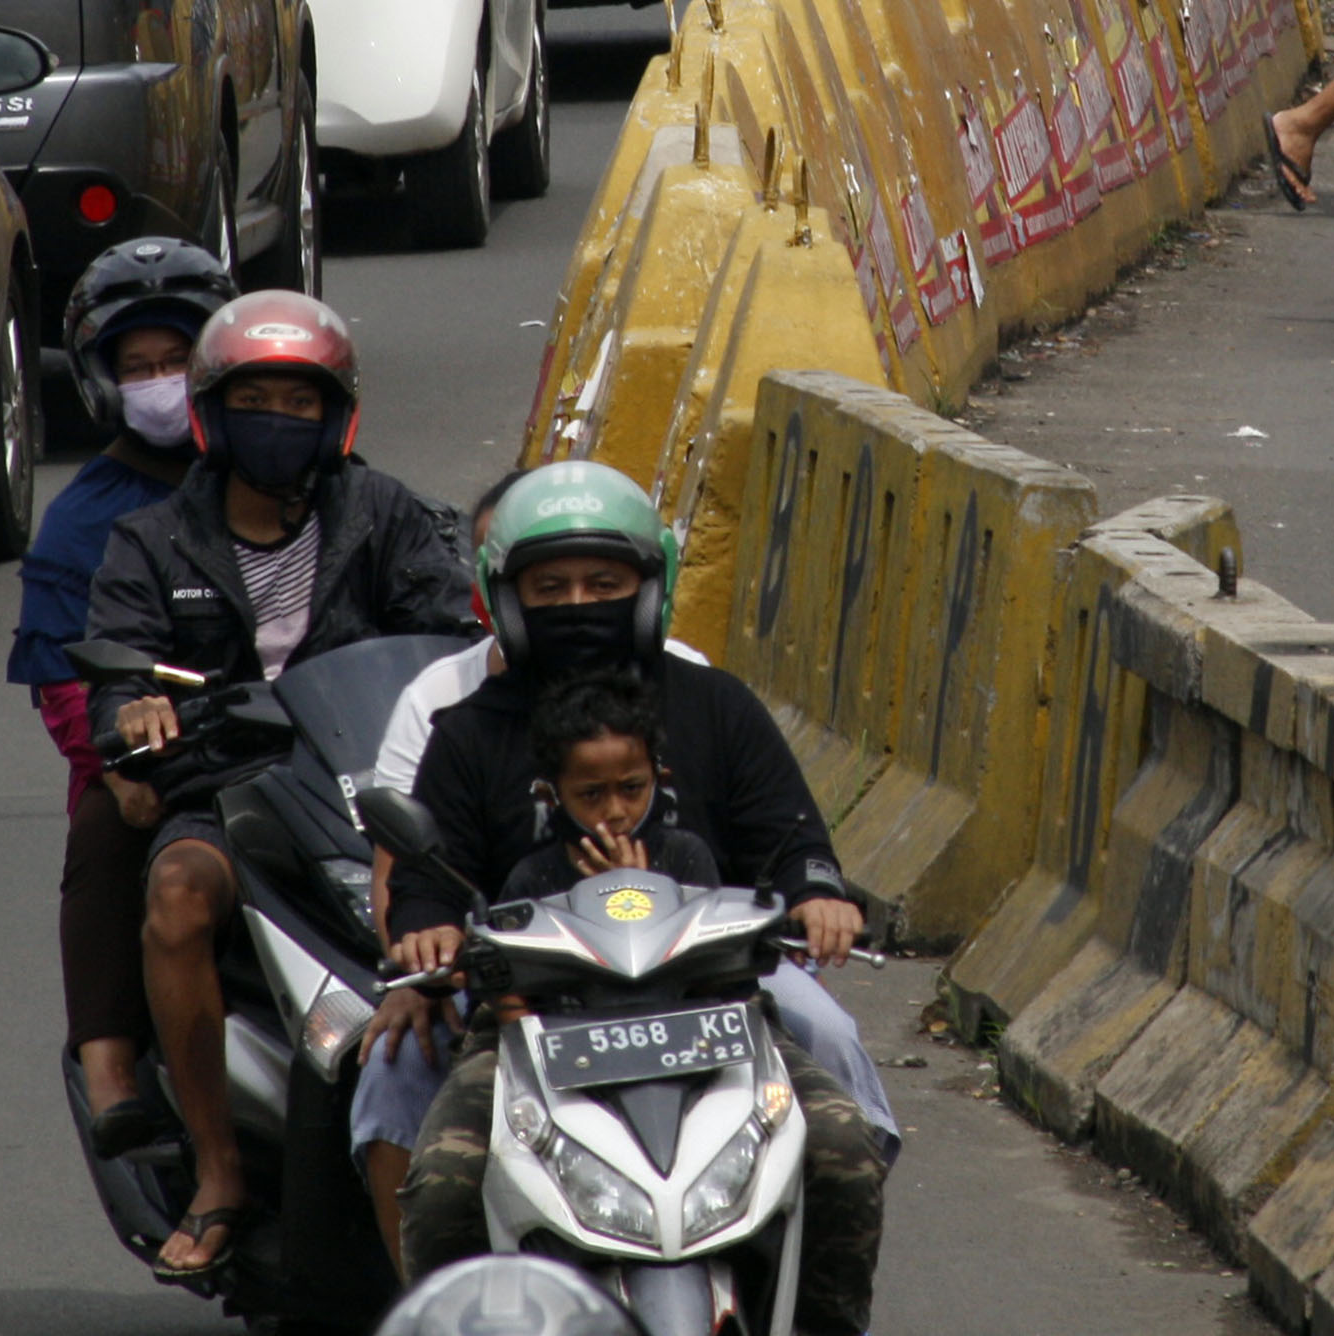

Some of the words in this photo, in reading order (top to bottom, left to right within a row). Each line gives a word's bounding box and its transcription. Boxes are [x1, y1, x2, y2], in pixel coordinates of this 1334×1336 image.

[536, 496, 604, 517] Grab
[172, 588, 202, 599] MOTOR
[337, 774, 356, 798] B
[545, 1035, 564, 1060] F
[588, 1021, 669, 1054] 5368
[699, 1009, 742, 1039] KC
